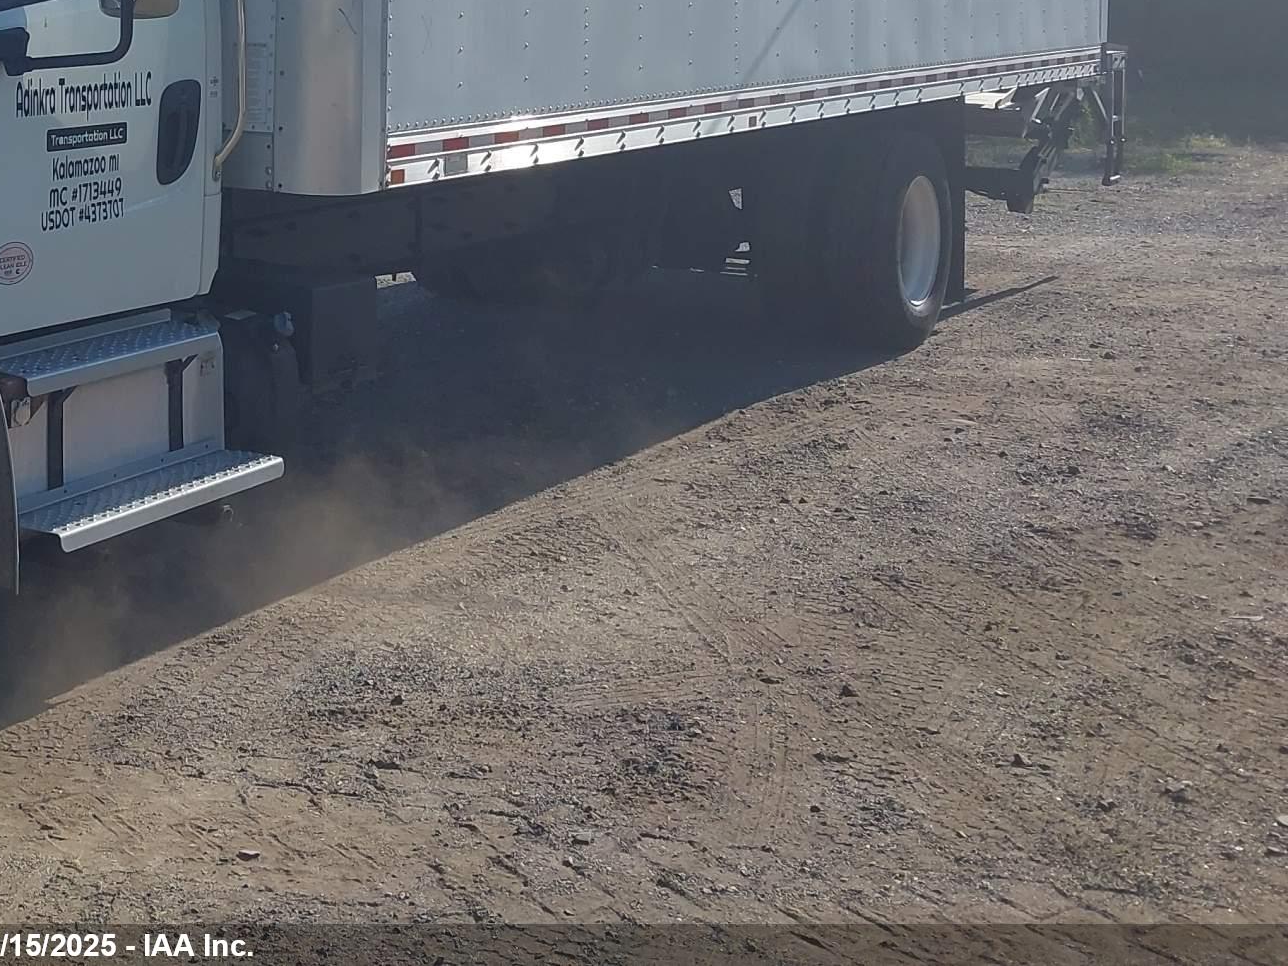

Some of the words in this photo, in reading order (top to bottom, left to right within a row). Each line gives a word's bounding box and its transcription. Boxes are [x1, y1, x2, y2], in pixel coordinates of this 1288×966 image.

[16, 77, 56, 118] Adinkra
[59, 71, 132, 122] Transportation
[135, 71, 152, 107] LLC
[51, 129, 108, 147] Transportation
[109, 127, 124, 140] LLC
[52, 155, 107, 181] Kalamazoo
[71, 177, 122, 203] #1713449
[41, 206, 76, 231] USDOT
